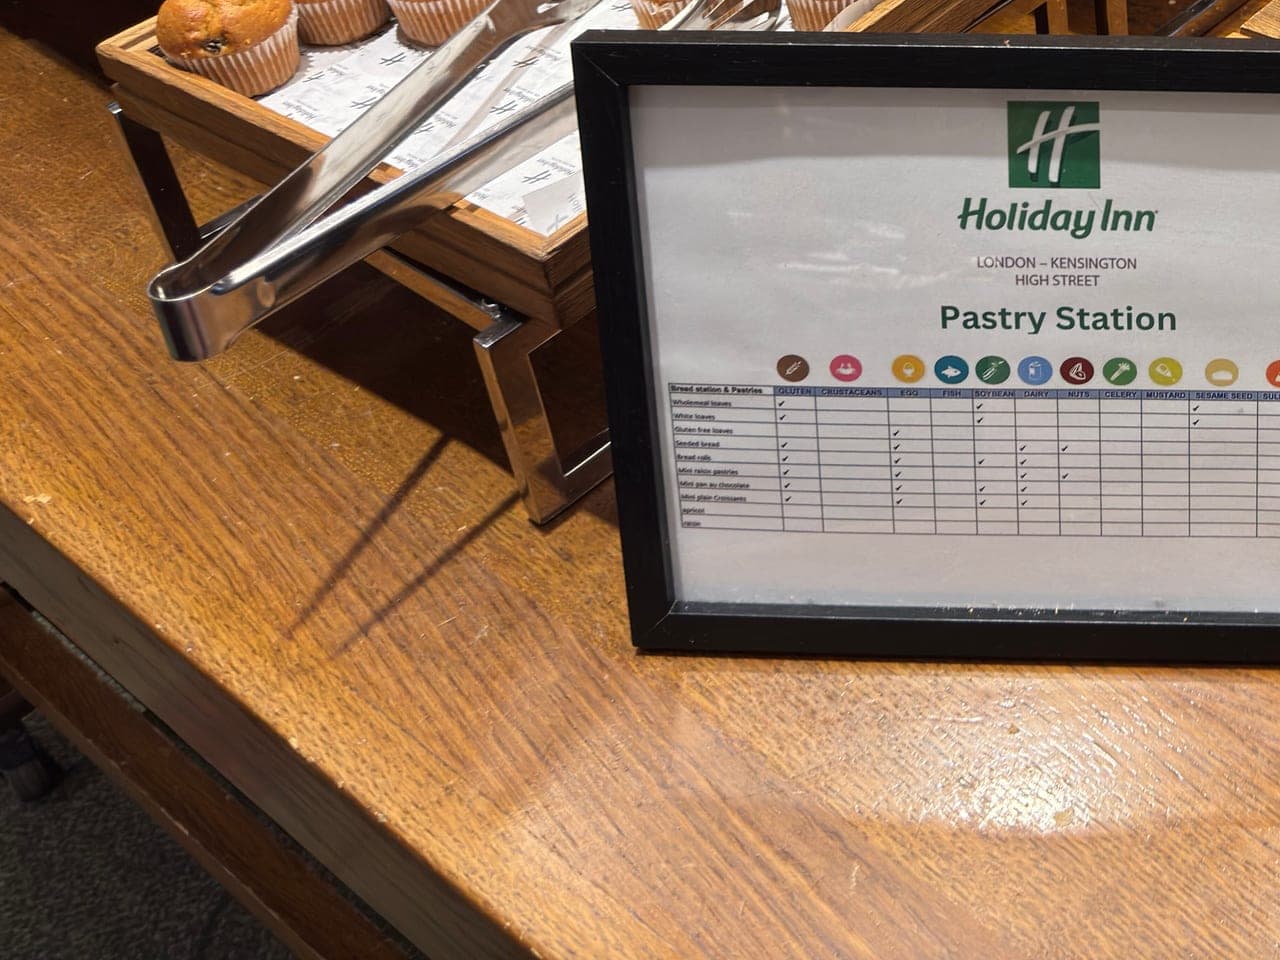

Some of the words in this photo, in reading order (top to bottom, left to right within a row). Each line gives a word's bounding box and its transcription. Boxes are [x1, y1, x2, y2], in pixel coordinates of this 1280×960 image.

[957, 197, 1095, 239] Holiday
[1100, 199, 1156, 232] Inn
[977, 256, 1036, 269] LONDON
[1051, 258, 1137, 270] KENSINGTON
[1015, 275, 1049, 286] HIGH
[1052, 275, 1100, 287] STREET
[941, 305, 1046, 335] Pastry
[1056, 306, 1176, 330] Station
[975, 390, 1014, 398] SOYBEAN
